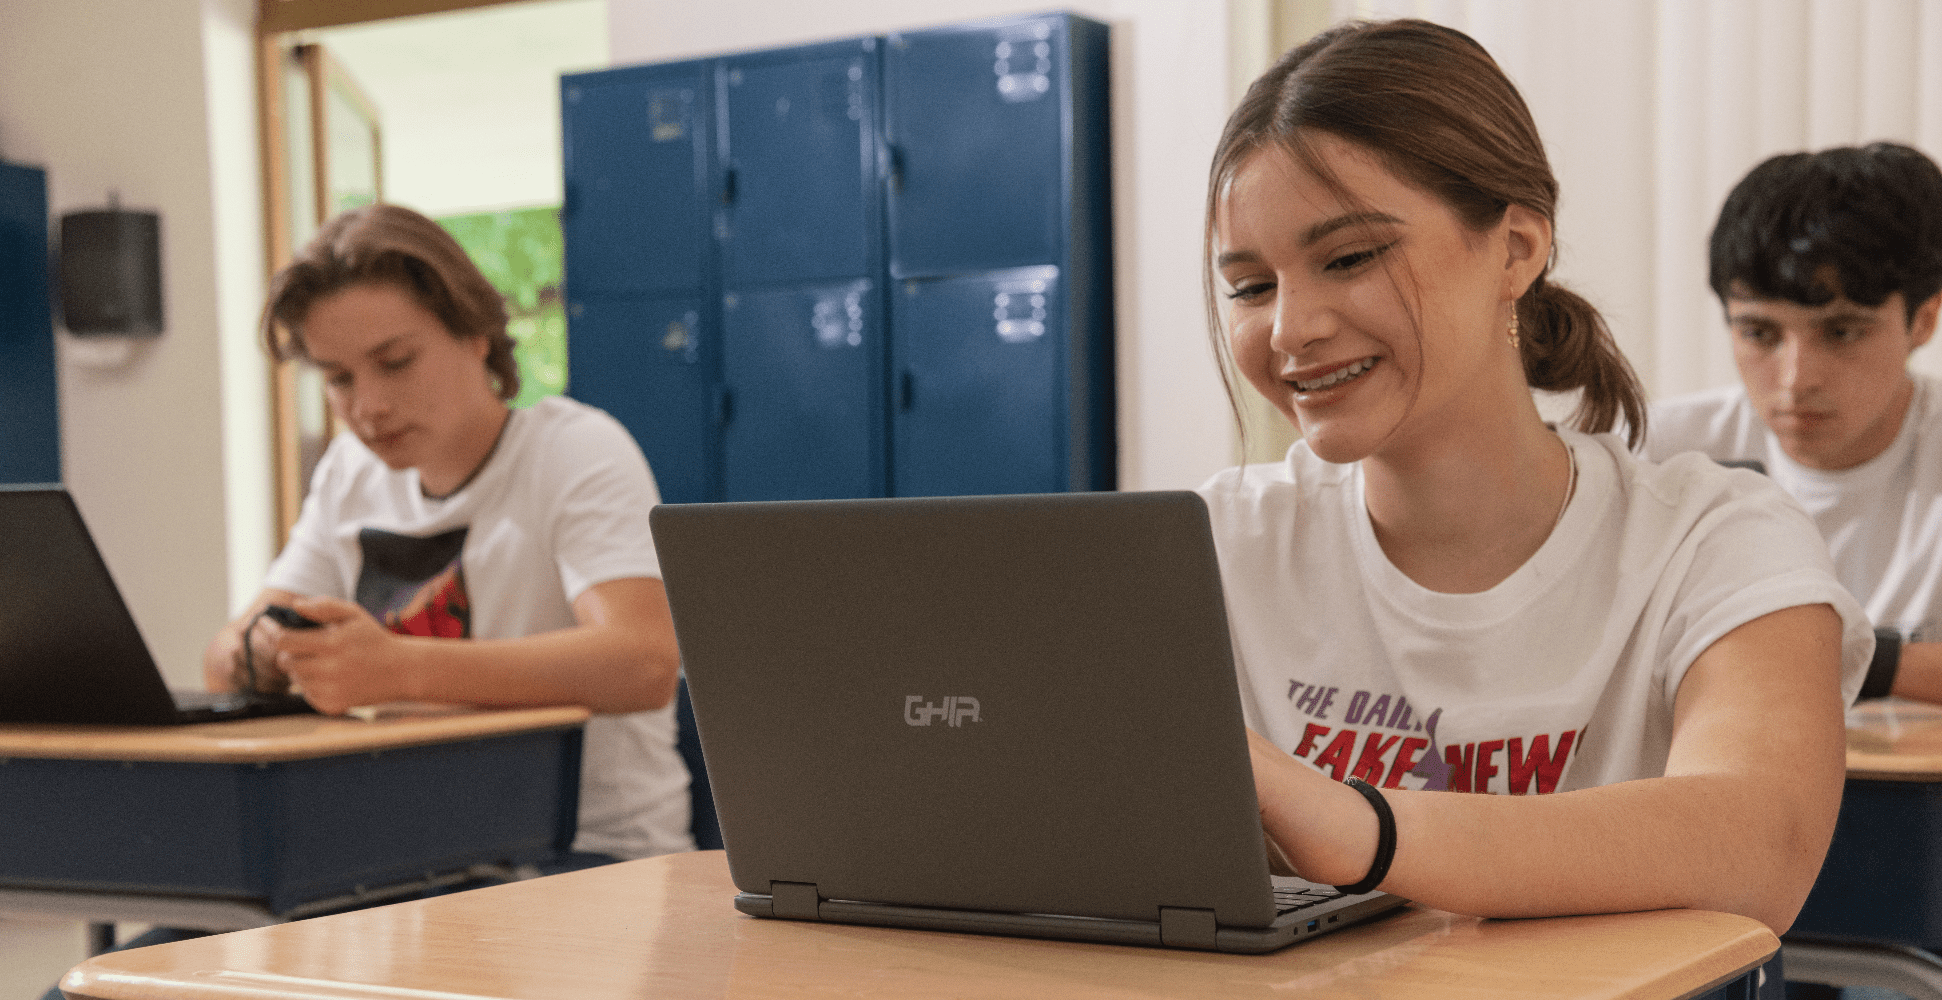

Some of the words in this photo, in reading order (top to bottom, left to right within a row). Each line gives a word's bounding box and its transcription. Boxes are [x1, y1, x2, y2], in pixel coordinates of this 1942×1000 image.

[904, 695, 981, 728] GHIA
[1287, 678, 1339, 720] THE
[1344, 690, 1423, 732] DAIL
[1444, 723, 1589, 796] NEW
